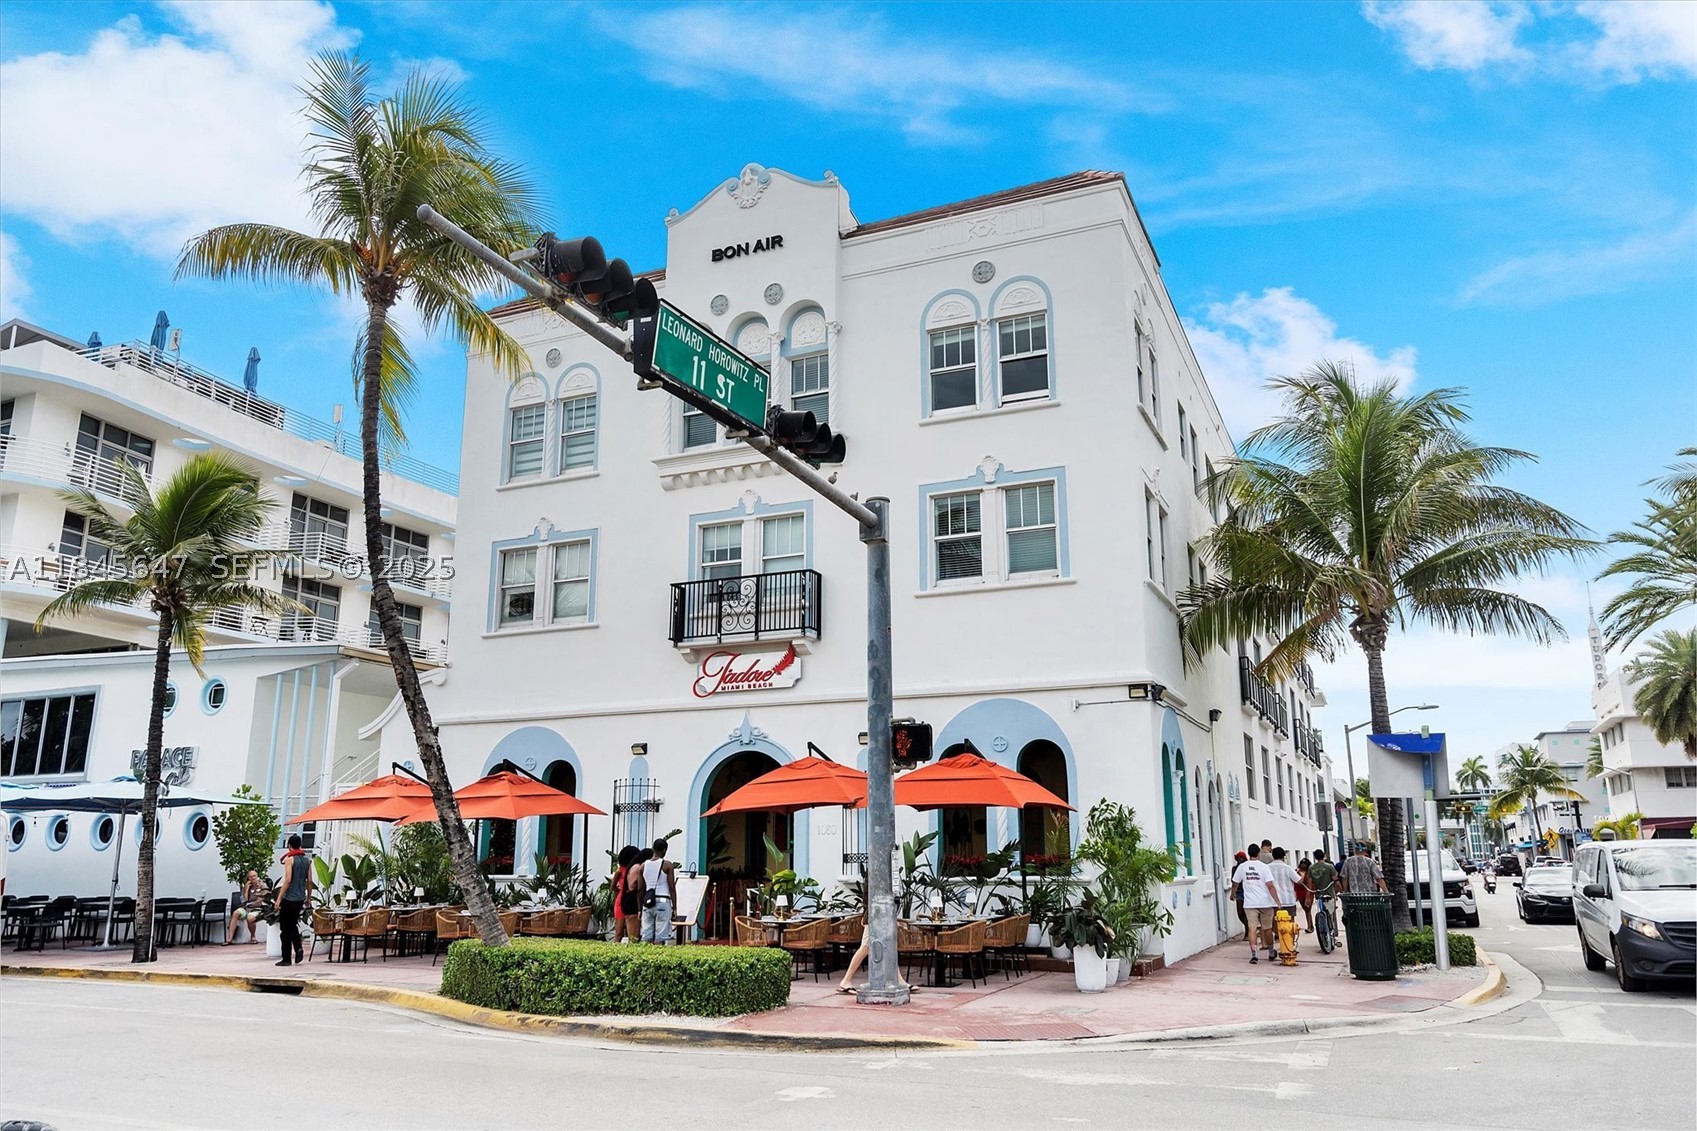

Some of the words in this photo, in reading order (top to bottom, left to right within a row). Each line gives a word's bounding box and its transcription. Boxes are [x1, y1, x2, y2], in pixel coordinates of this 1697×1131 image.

[711, 242, 750, 262] BON
[752, 234, 784, 254] AIR
[661, 312, 704, 353] LEONARD
[708, 343, 750, 383] HOROWITZ
[753, 373, 764, 393] PL
[692, 355, 707, 391] 11
[715, 373, 736, 404] ST
[720, 684, 745, 692] MIAMI
[747, 682, 774, 690] BEACH
[129, 746, 195, 770] PAACE
